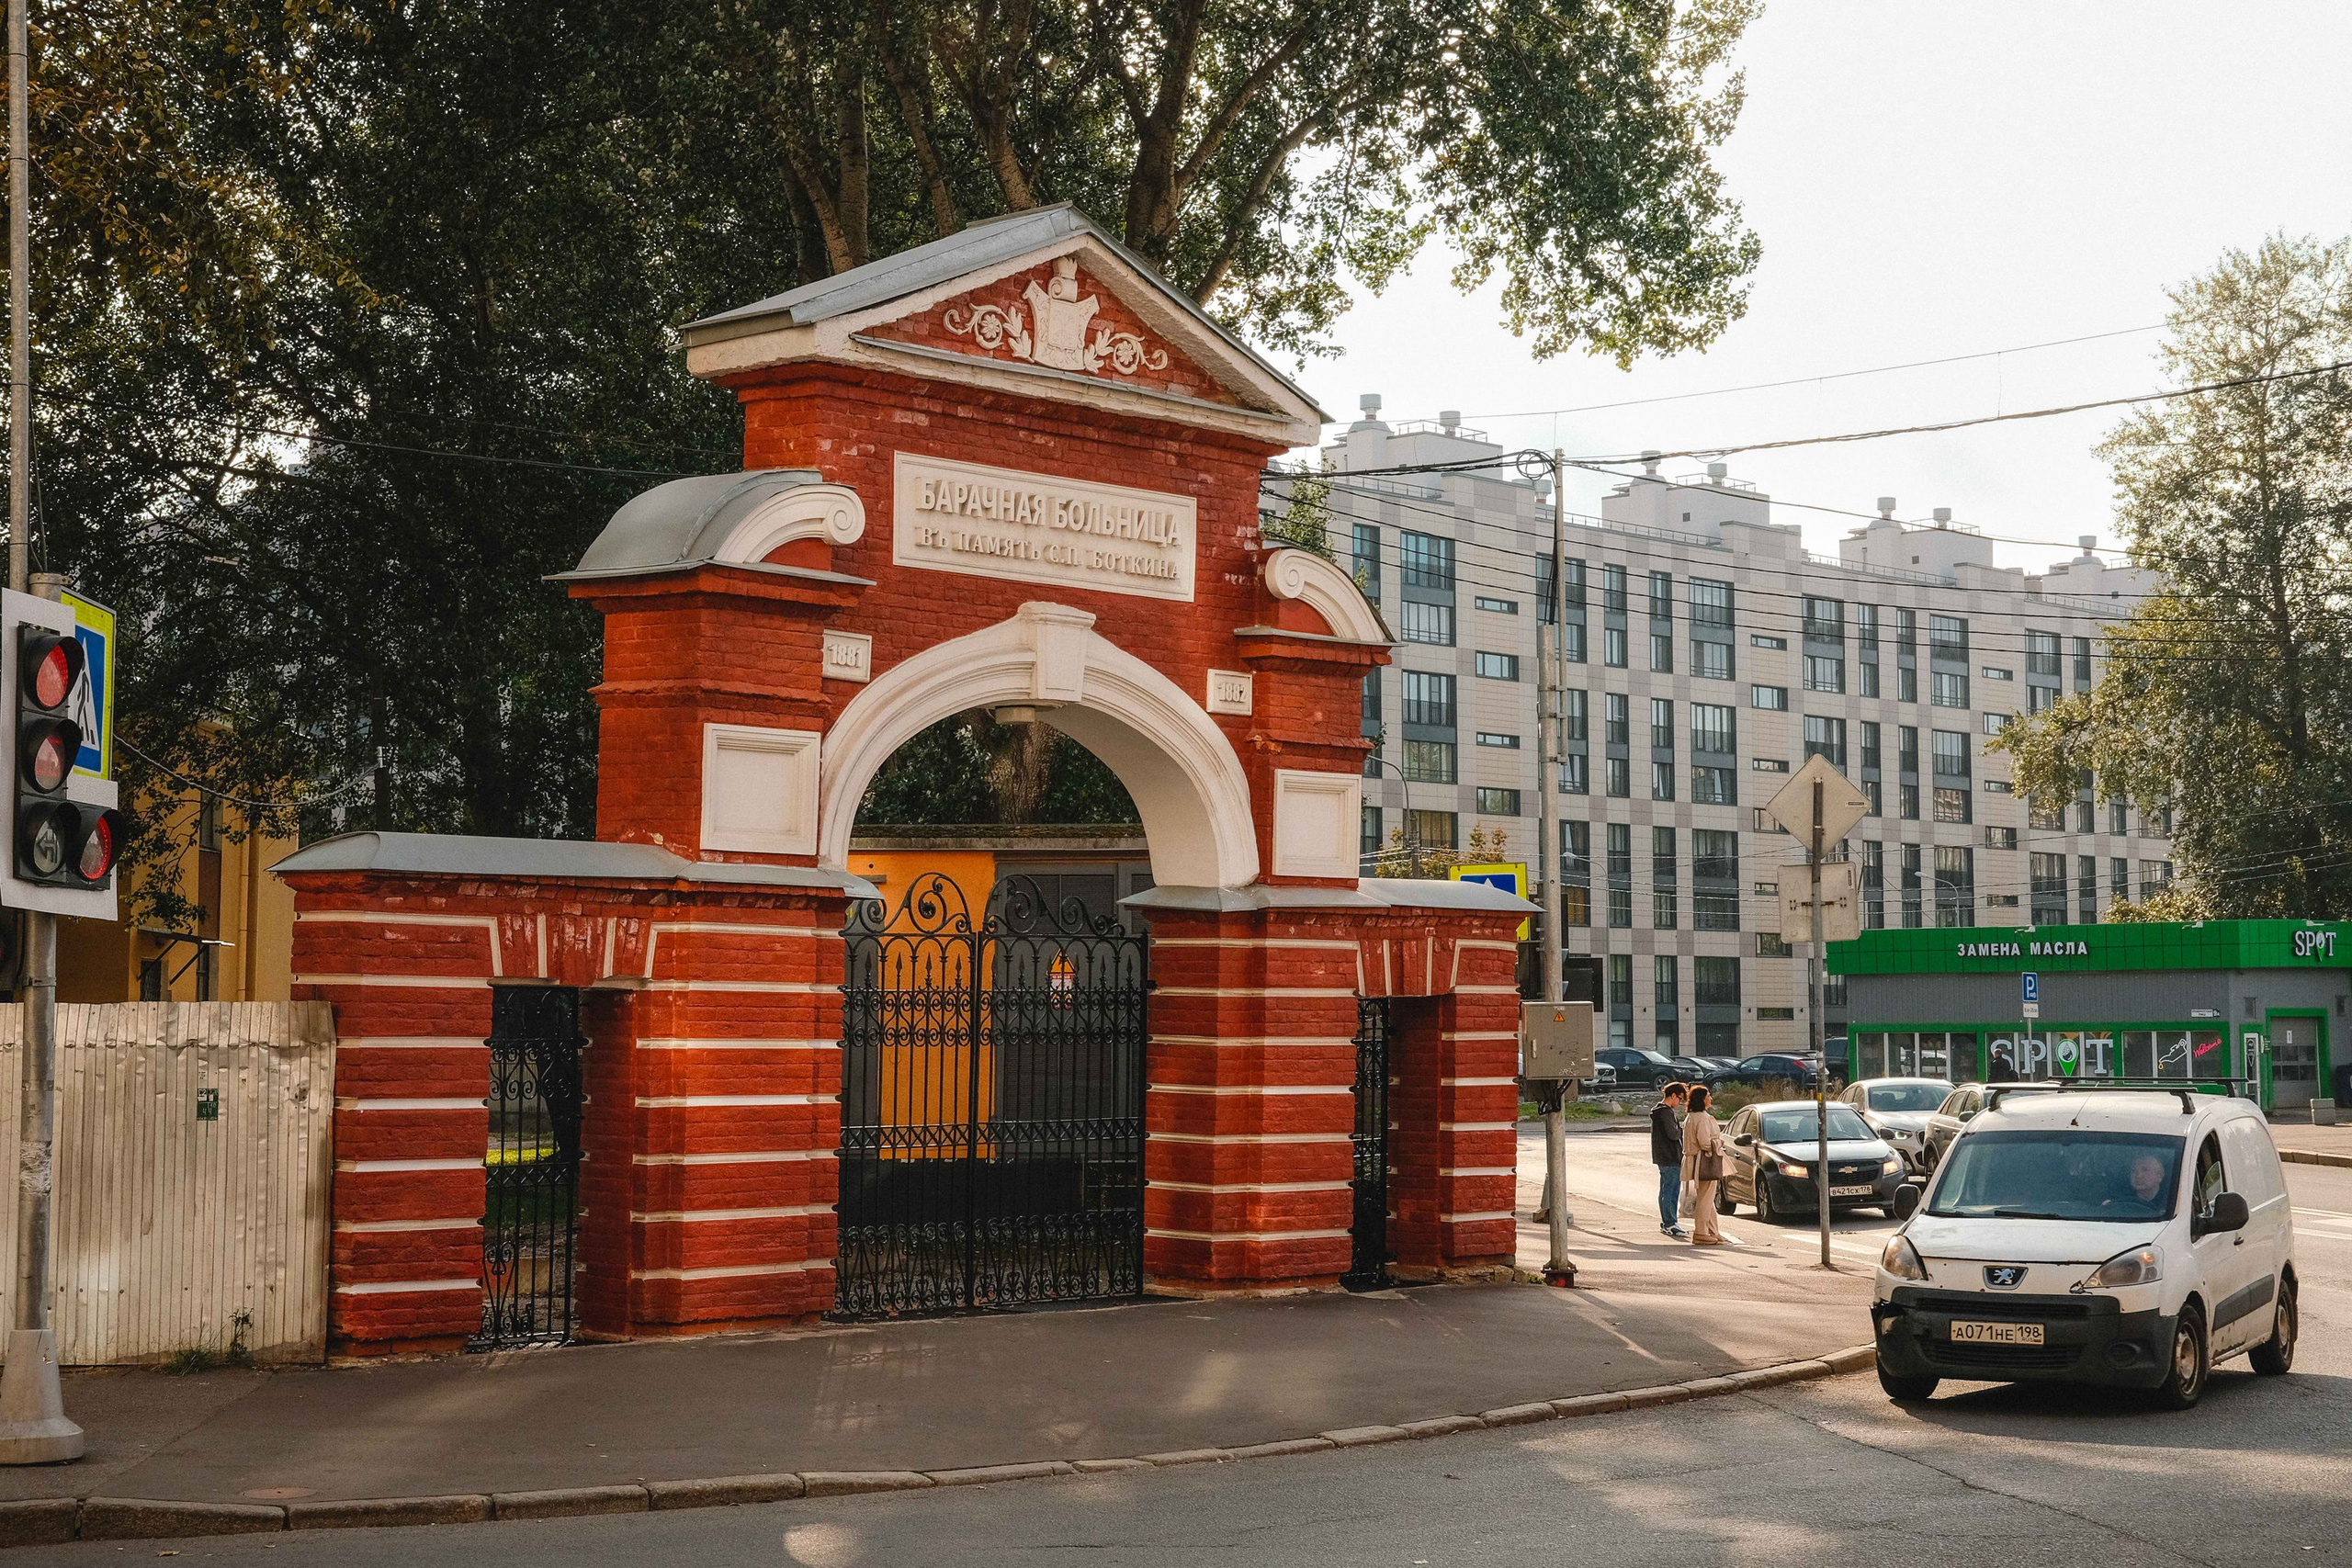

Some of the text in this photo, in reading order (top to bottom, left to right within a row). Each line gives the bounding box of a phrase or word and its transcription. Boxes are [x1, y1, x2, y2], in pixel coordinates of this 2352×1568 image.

[917, 477, 1182, 548] БАРАЧНАЯ БОЛЬНИЦА
[917, 526, 950, 549] ВЪ
[954, 531, 1042, 561] ПАМЯТЬ
[1089, 549, 1180, 581] БОТКИНА
[827, 644, 862, 668] 1881
[1216, 682, 1247, 704] 1882
[1957, 941, 2088, 956] ЗАМЕНА МАСЛА
[2294, 930, 2337, 962] SPOT
[1955, 1324, 2041, 1341] А071НЕ 198
